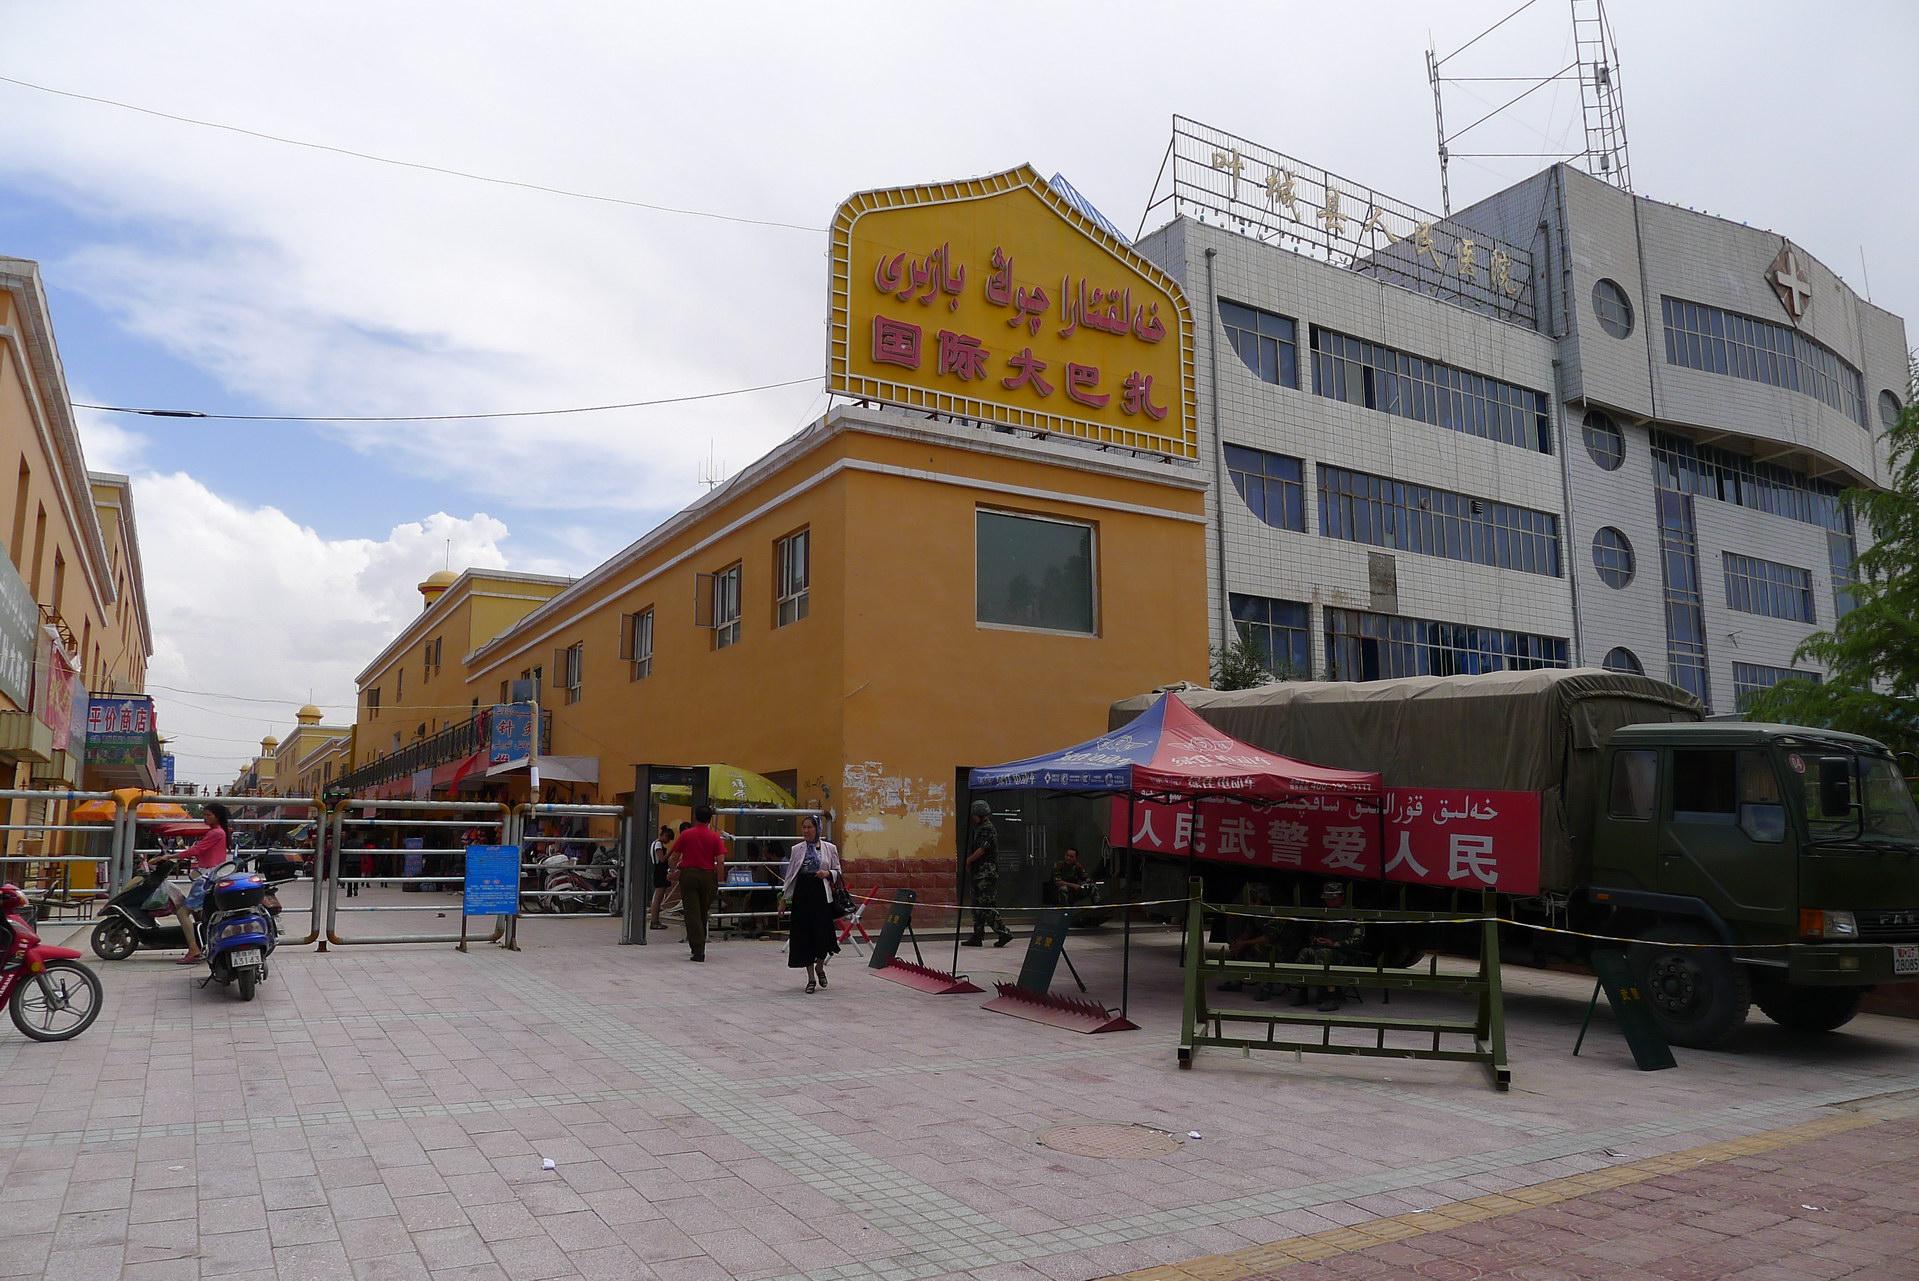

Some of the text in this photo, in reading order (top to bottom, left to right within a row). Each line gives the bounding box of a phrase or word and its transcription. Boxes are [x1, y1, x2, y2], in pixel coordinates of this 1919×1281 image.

[871, 314, 1169, 421] 国际大巴扎
[88, 705, 149, 734] 平价商店
[1131, 808, 1499, 885] 人民武警爱人民
